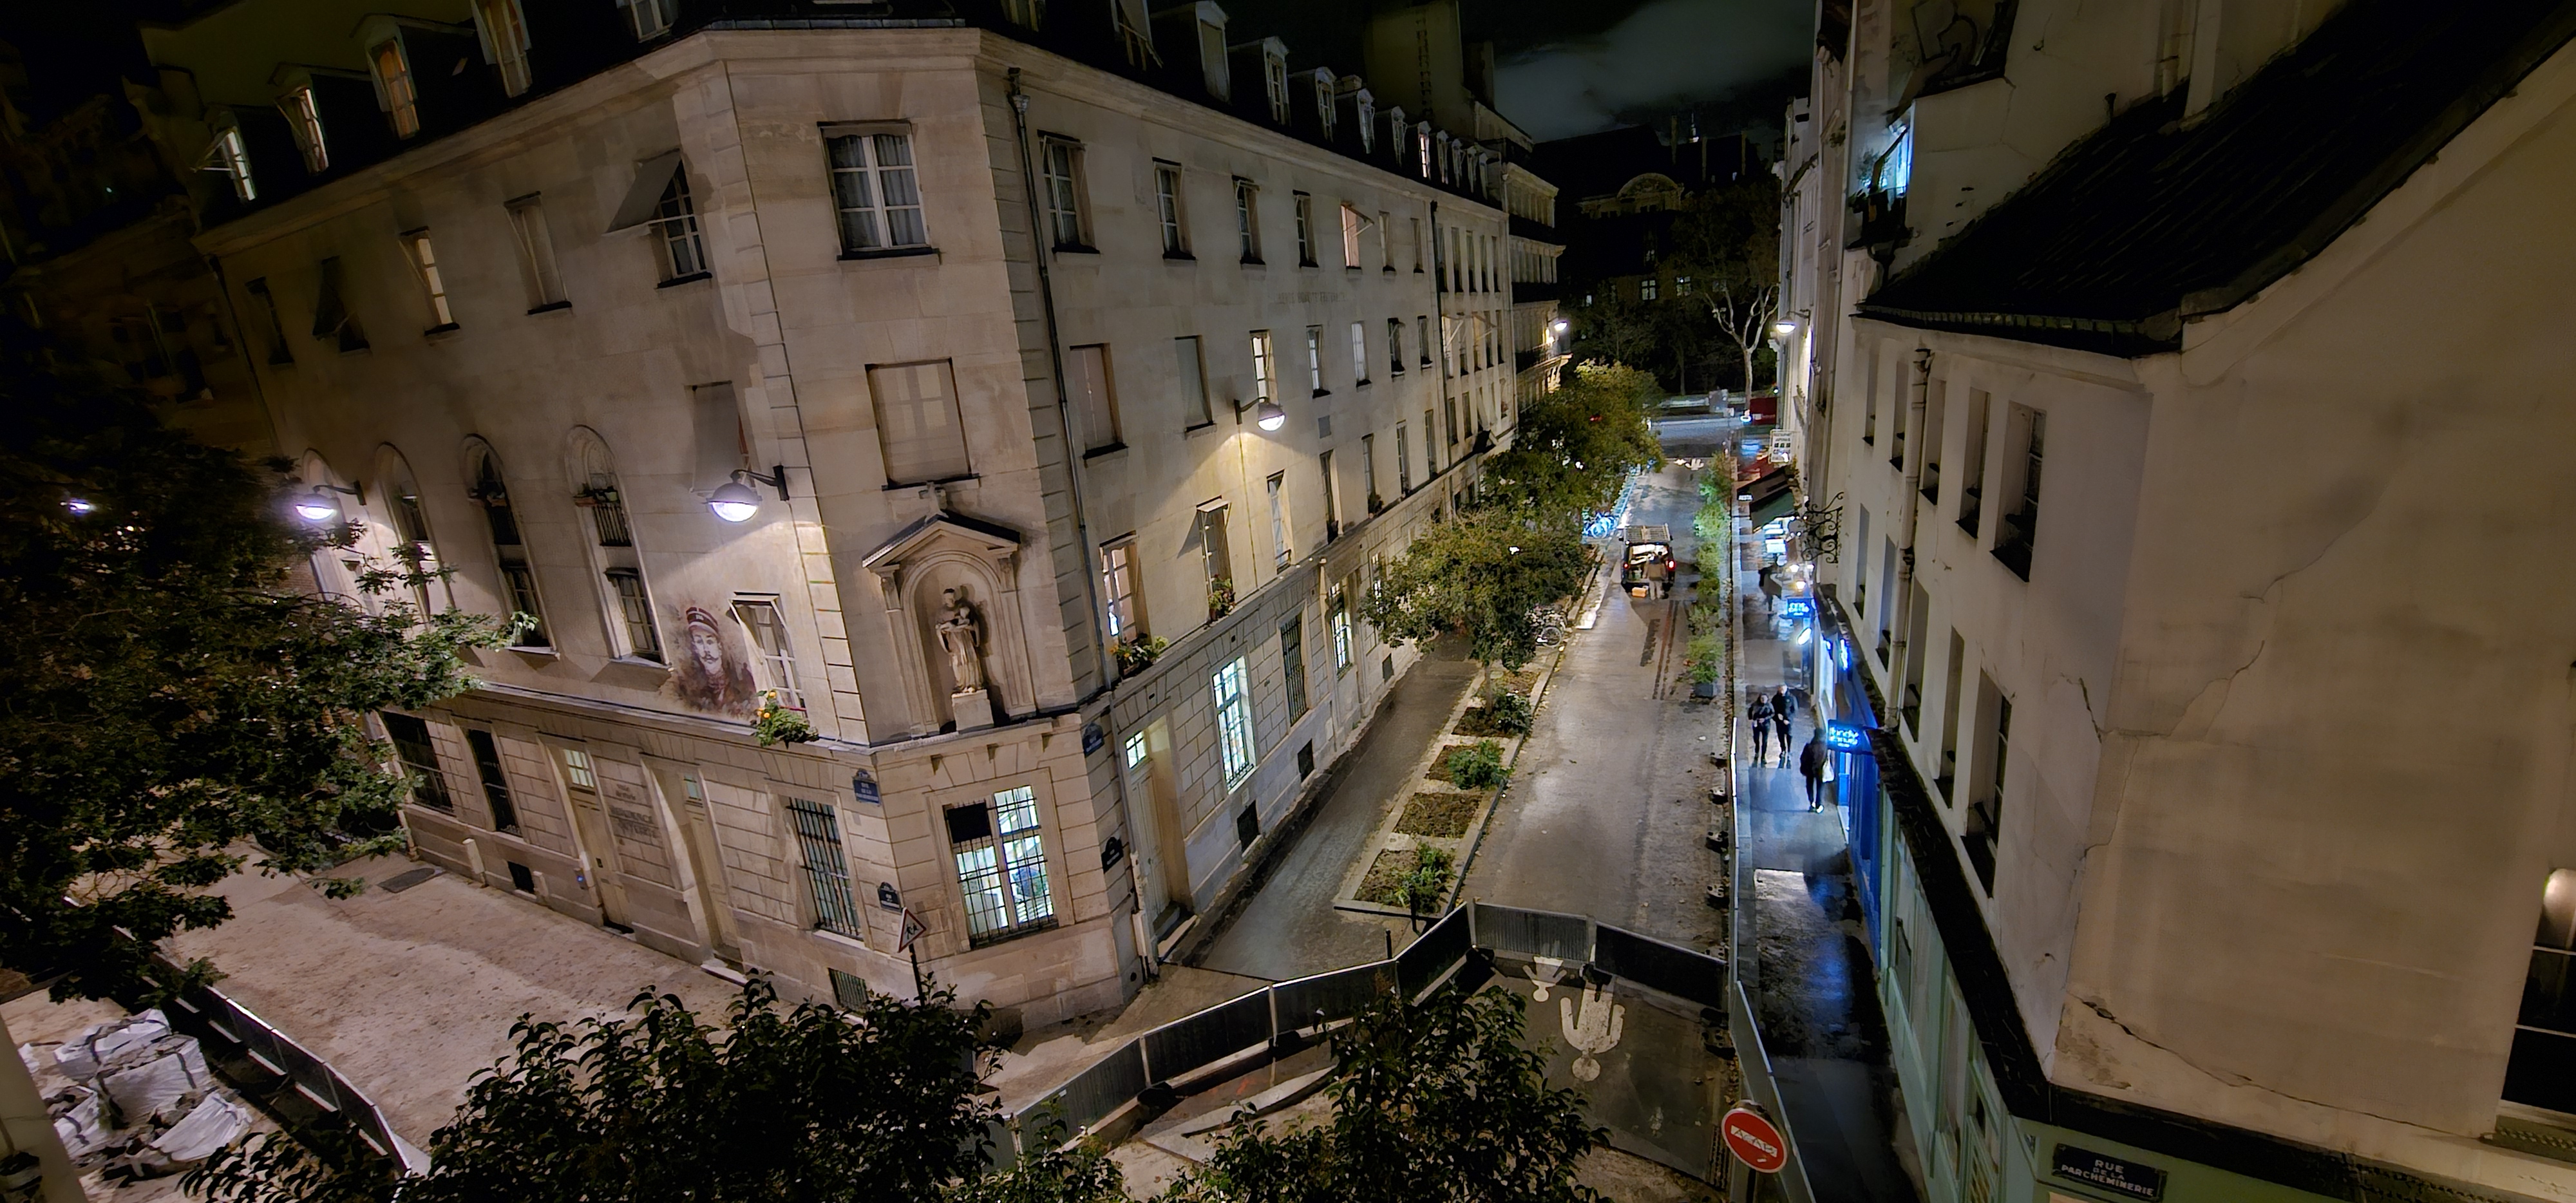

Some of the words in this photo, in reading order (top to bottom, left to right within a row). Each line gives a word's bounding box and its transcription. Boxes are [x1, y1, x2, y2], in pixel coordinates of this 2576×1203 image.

[2095, 1159, 2124, 1173] RUE
[2061, 1164, 2155, 1197] PARCHEMINERIE
[2093, 1167, 2108, 1176] DE
[2110, 1172, 2125, 1180] LA
